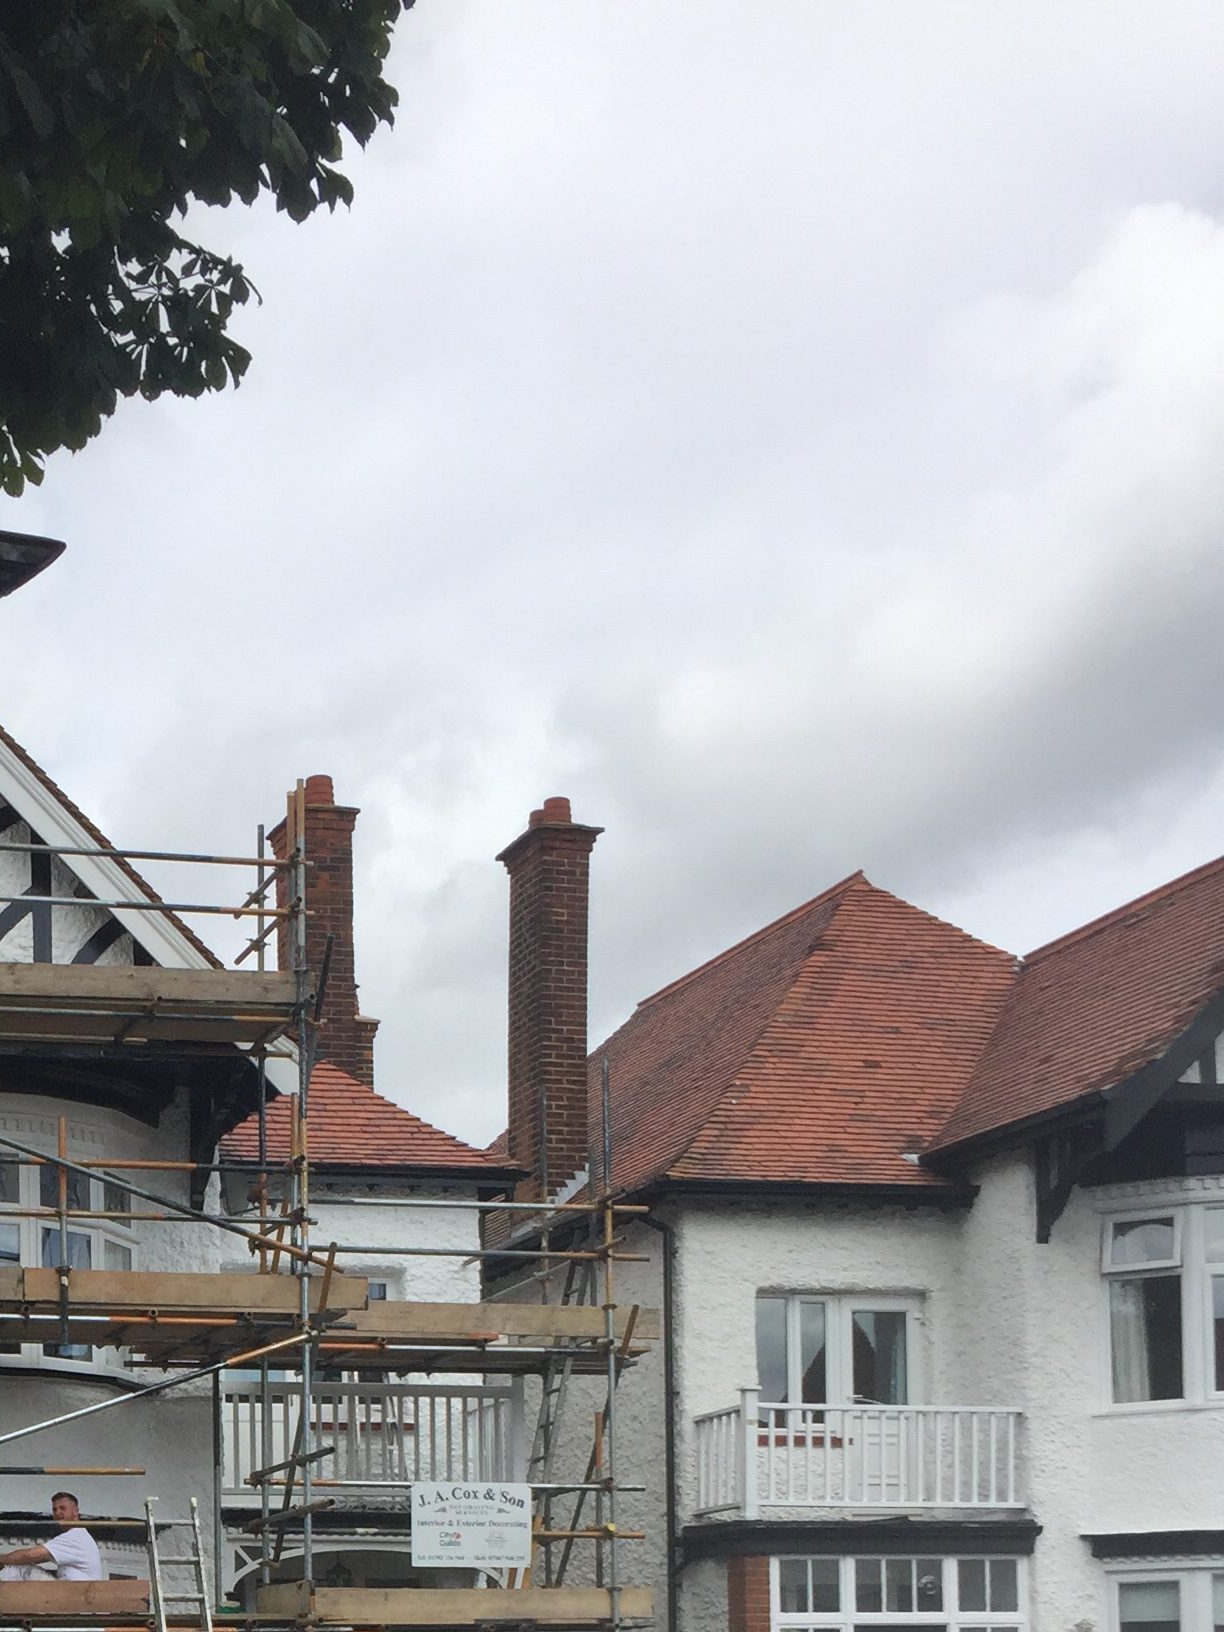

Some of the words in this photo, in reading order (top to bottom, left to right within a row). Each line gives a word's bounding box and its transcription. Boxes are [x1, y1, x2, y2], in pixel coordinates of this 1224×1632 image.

[451, 1487, 479, 1501] Cox
[483, 1488, 495, 1502] &
[500, 1489, 525, 1509] Son
[488, 1520, 528, 1529] Decorating
